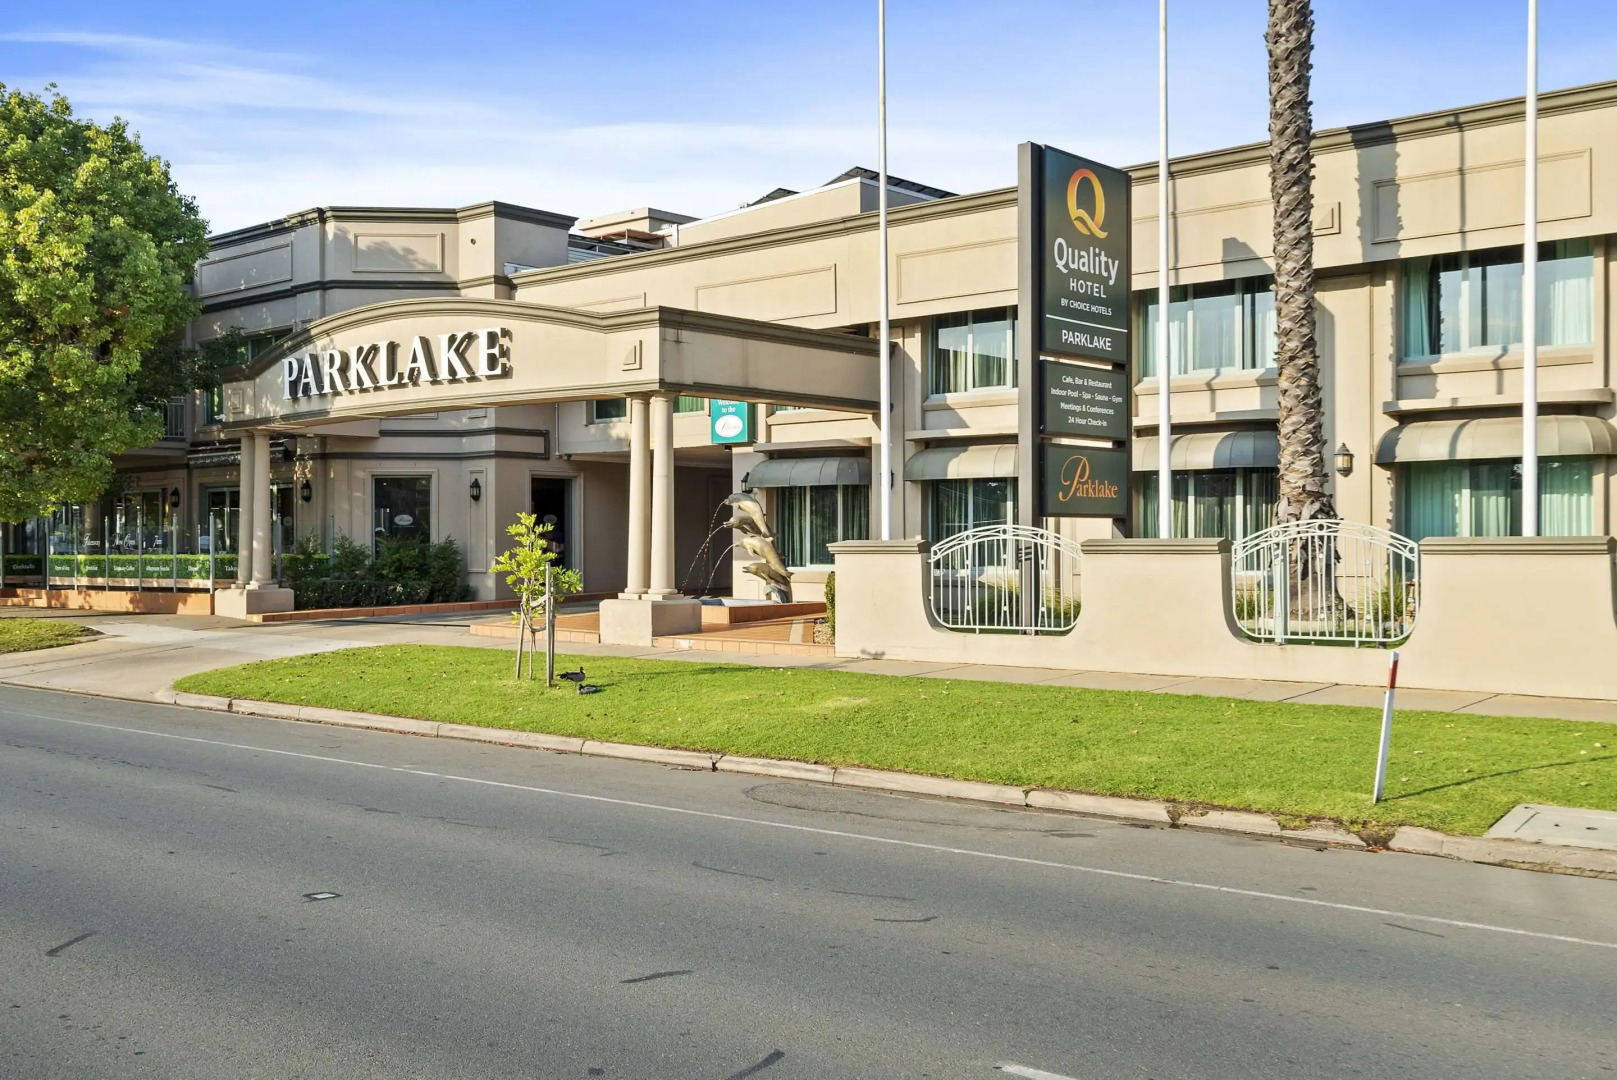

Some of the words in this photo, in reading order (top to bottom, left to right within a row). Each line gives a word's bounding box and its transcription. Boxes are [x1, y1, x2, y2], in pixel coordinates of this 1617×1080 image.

[1054, 237, 1119, 286] Quality
[1069, 277, 1107, 298] HOTEL
[1061, 298, 1069, 306] BY
[1069, 300, 1090, 311] CHOICE
[1090, 304, 1112, 315] HOTELS
[1061, 329, 1112, 351] PARKLAKE
[282, 327, 513, 400] PARKLAKE
[1062, 375, 1075, 384] Cafe,
[1075, 377, 1083, 385] Bar
[1088, 379, 1112, 388] Restaurant
[1050, 387, 1067, 396] Indoor
[1067, 389, 1079, 398] Pool
[1081, 391, 1092, 400] Spa
[1094, 392, 1109, 402] Sauna
[1112, 395, 1122, 403] Gym
[1060, 402, 1081, 412] Meetings
[1087, 405, 1114, 414] Conferences
[1067, 415, 1075, 424] 24
[1075, 416, 1087, 425] Hour
[1087, 418, 1107, 426] Check-in
[1058, 455, 1118, 502] Parklake
